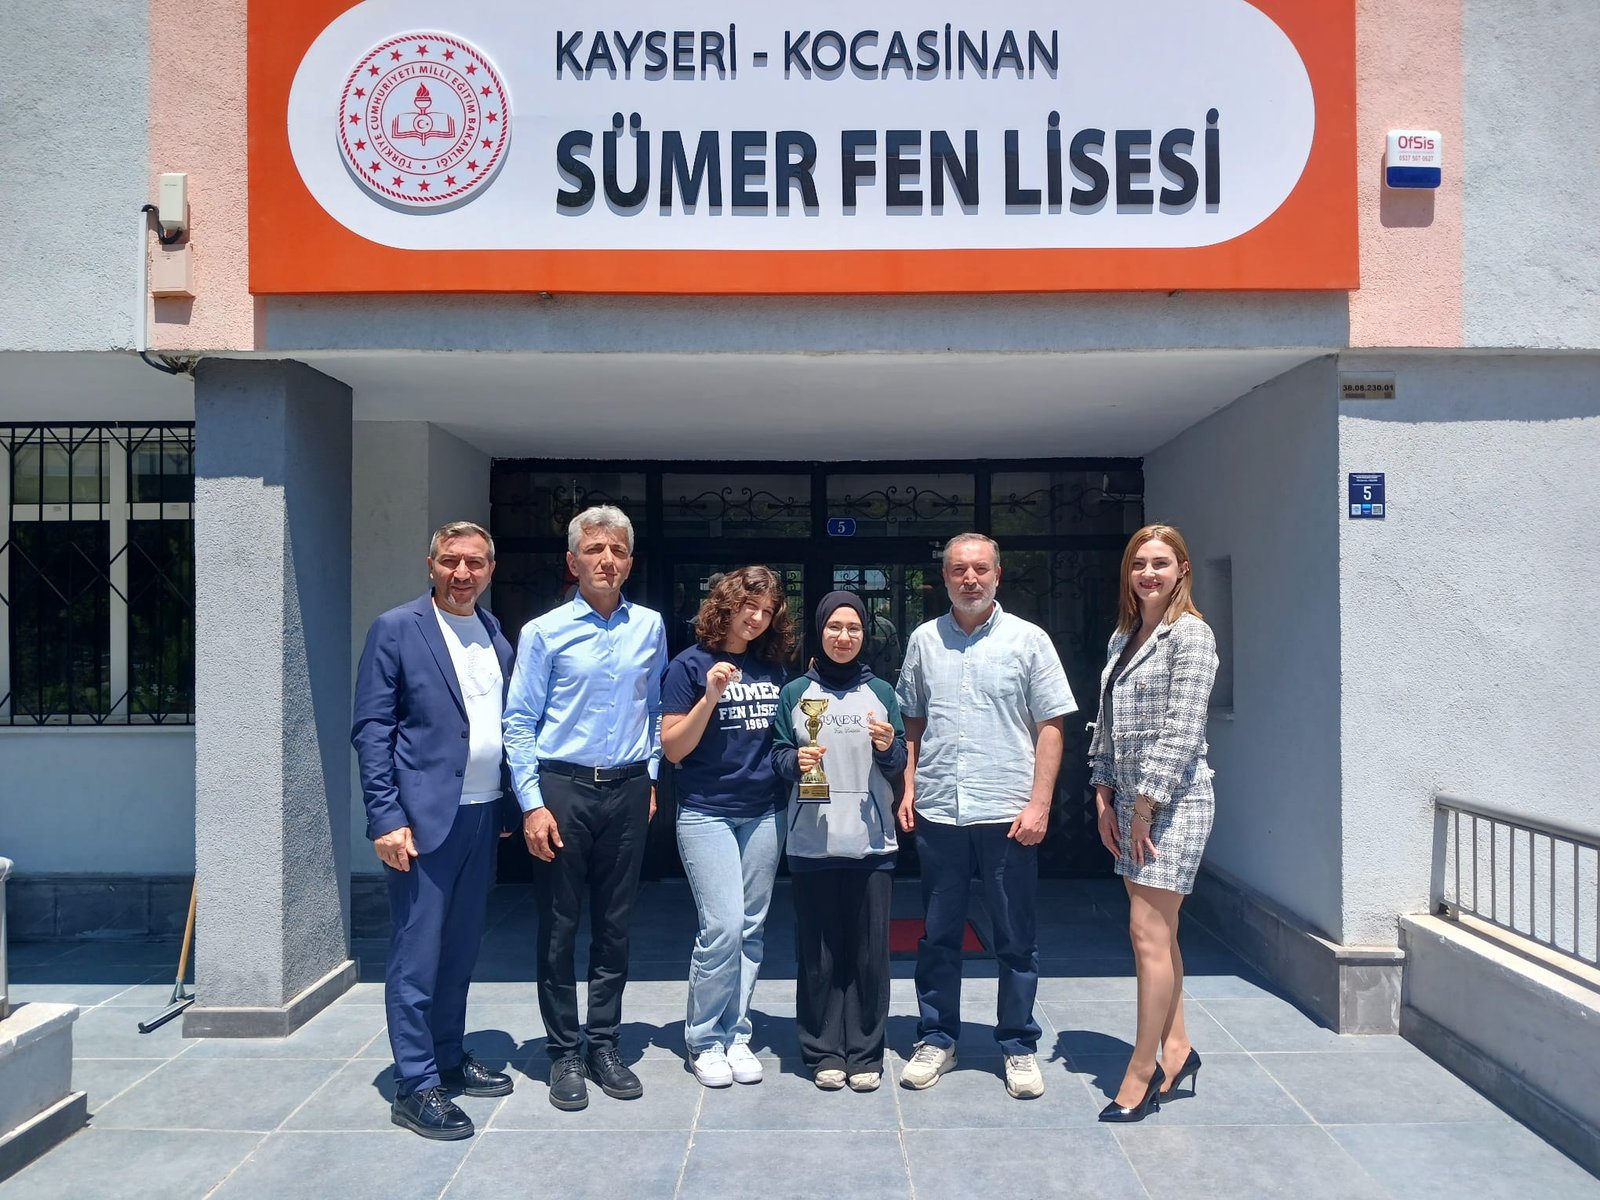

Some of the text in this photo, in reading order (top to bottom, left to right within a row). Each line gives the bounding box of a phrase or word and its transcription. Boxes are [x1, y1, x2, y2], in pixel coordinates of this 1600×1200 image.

[556, 23, 737, 73] KAYSERİ
[784, 23, 1058, 72] KOCASİNAN
[371, 65, 476, 169] TÜRKİYE CUMHURİYETİ MİLLİ EĞİTİM BAKANLIĞI
[1398, 135, 1435, 150] OfSis
[556, 108, 1221, 209] SÜMER FEN LİSESİ
[1363, 485, 1372, 501] 5
[837, 521, 846, 534] 5
[719, 701, 779, 720] FEN LİSE
